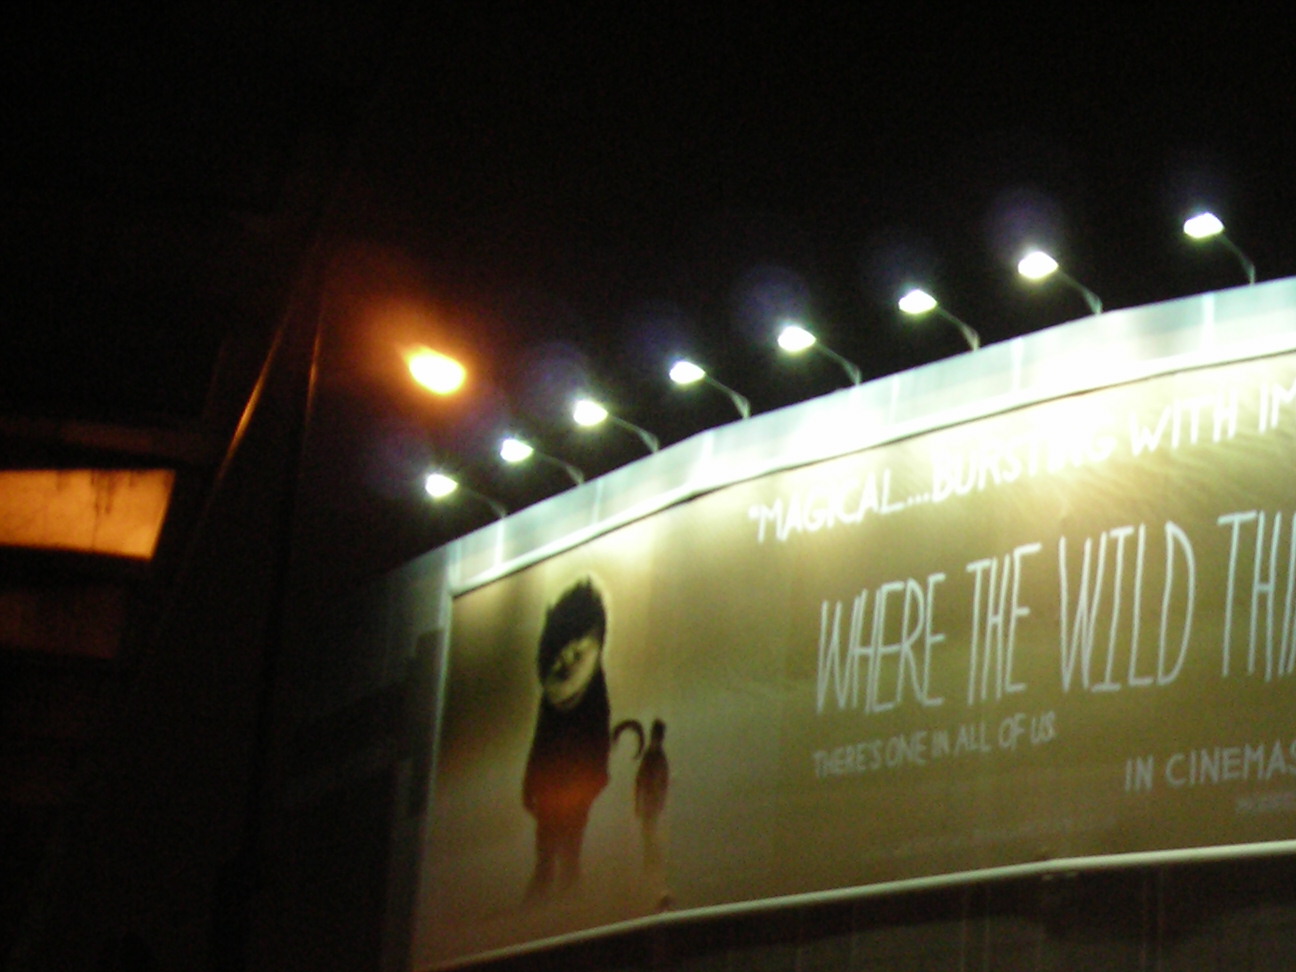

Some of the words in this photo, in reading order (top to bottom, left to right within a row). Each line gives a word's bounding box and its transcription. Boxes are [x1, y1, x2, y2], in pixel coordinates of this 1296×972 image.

[1128, 384, 1239, 457] WITH
[815, 572, 947, 714] WHERE
[965, 541, 1043, 706] THE
[1058, 519, 1197, 694] WILD
[813, 739, 883, 779] THERE'S
[885, 730, 928, 768] ONE
[931, 728, 950, 757] IN
[955, 721, 991, 756] ALL
[999, 711, 1026, 750] OF
[1124, 755, 1153, 792] IN
